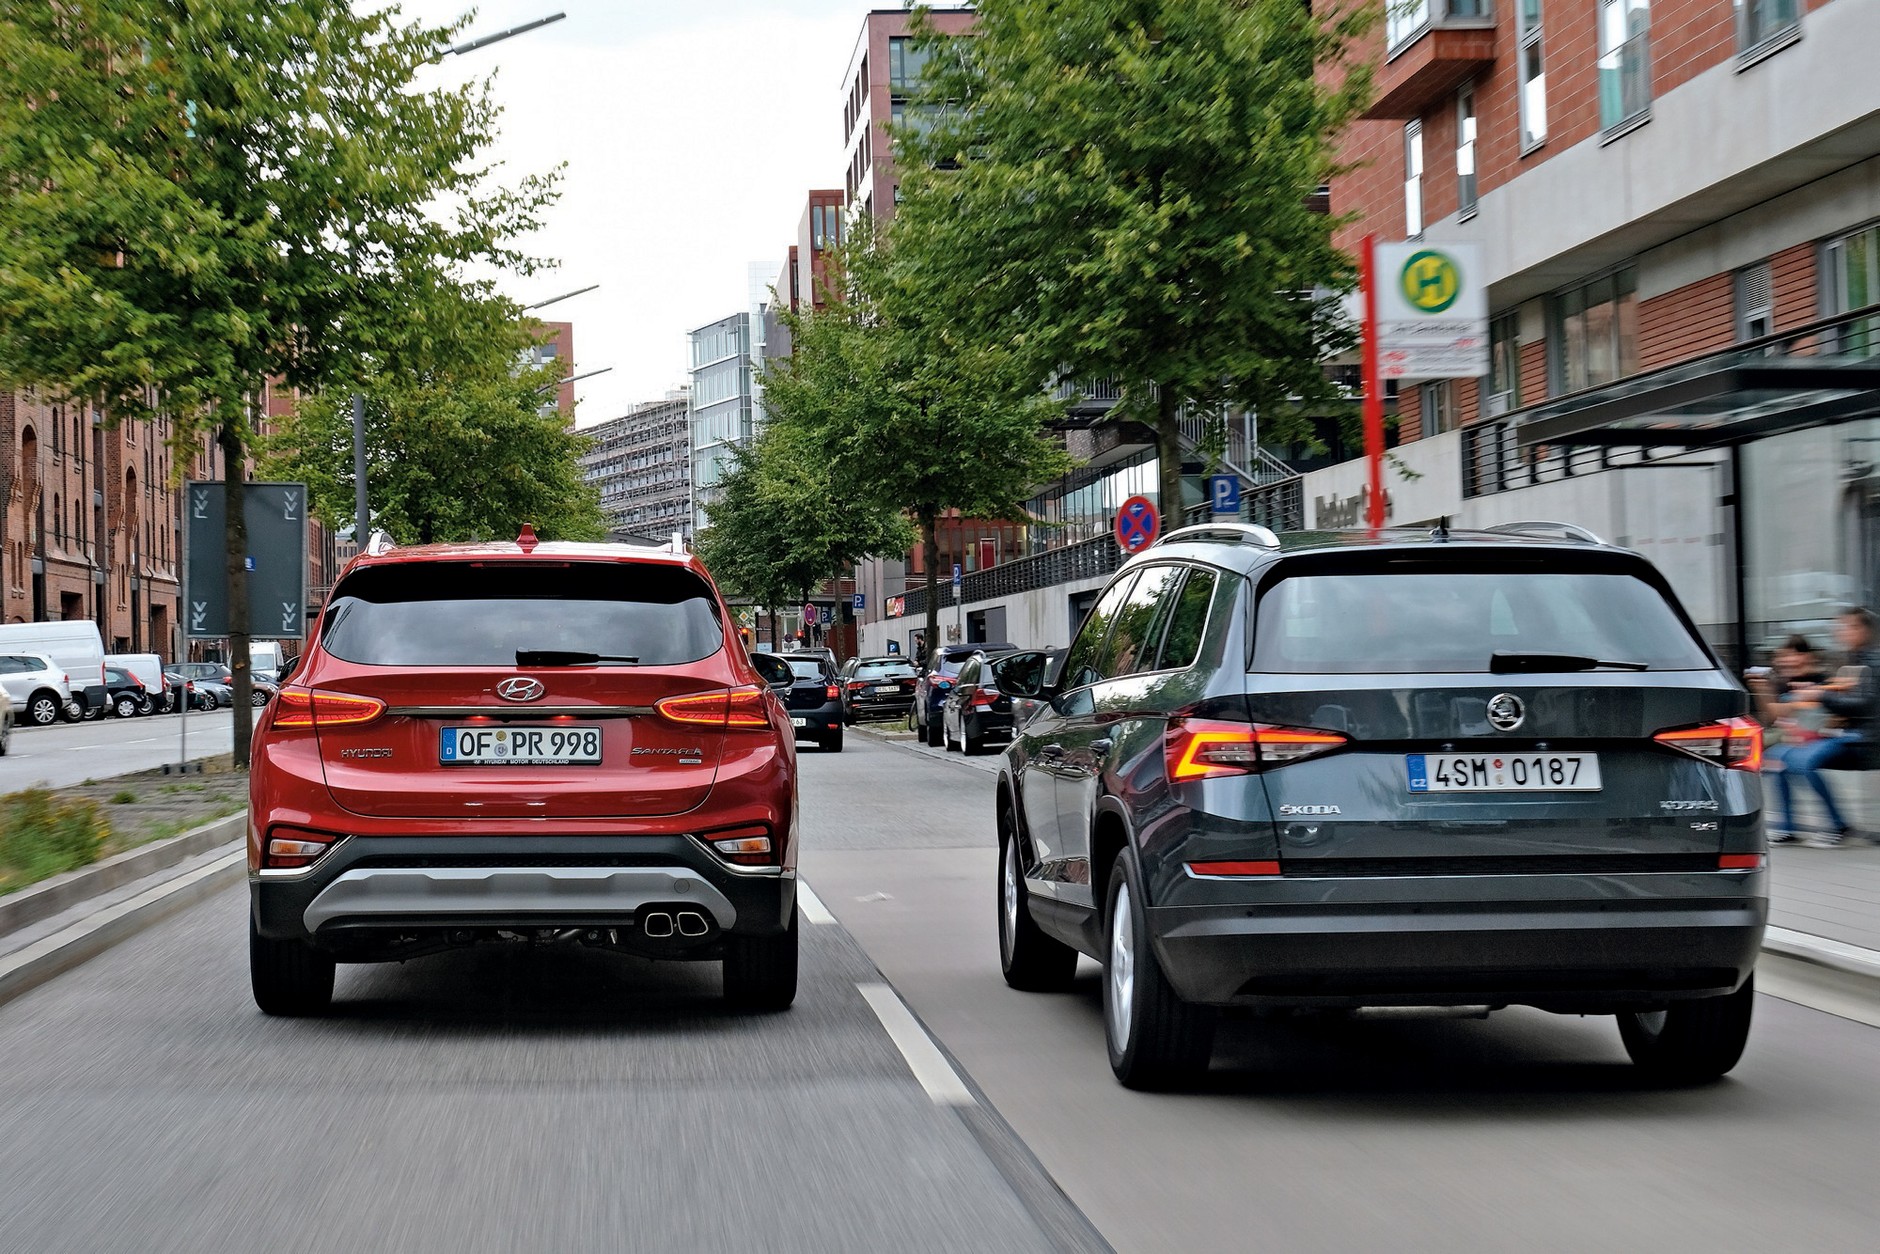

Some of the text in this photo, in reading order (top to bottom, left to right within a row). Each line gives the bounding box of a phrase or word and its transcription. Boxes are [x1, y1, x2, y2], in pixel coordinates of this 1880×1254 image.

[1215, 479, 1232, 508] P
[854, 595, 862, 607] P
[459, 731, 598, 756] OF PR 998
[341, 748, 393, 758] HYUNDAI
[446, 747, 453, 755] D
[1435, 757, 1581, 787] 4SM 0187
[1410, 778, 1427, 788] CZ
